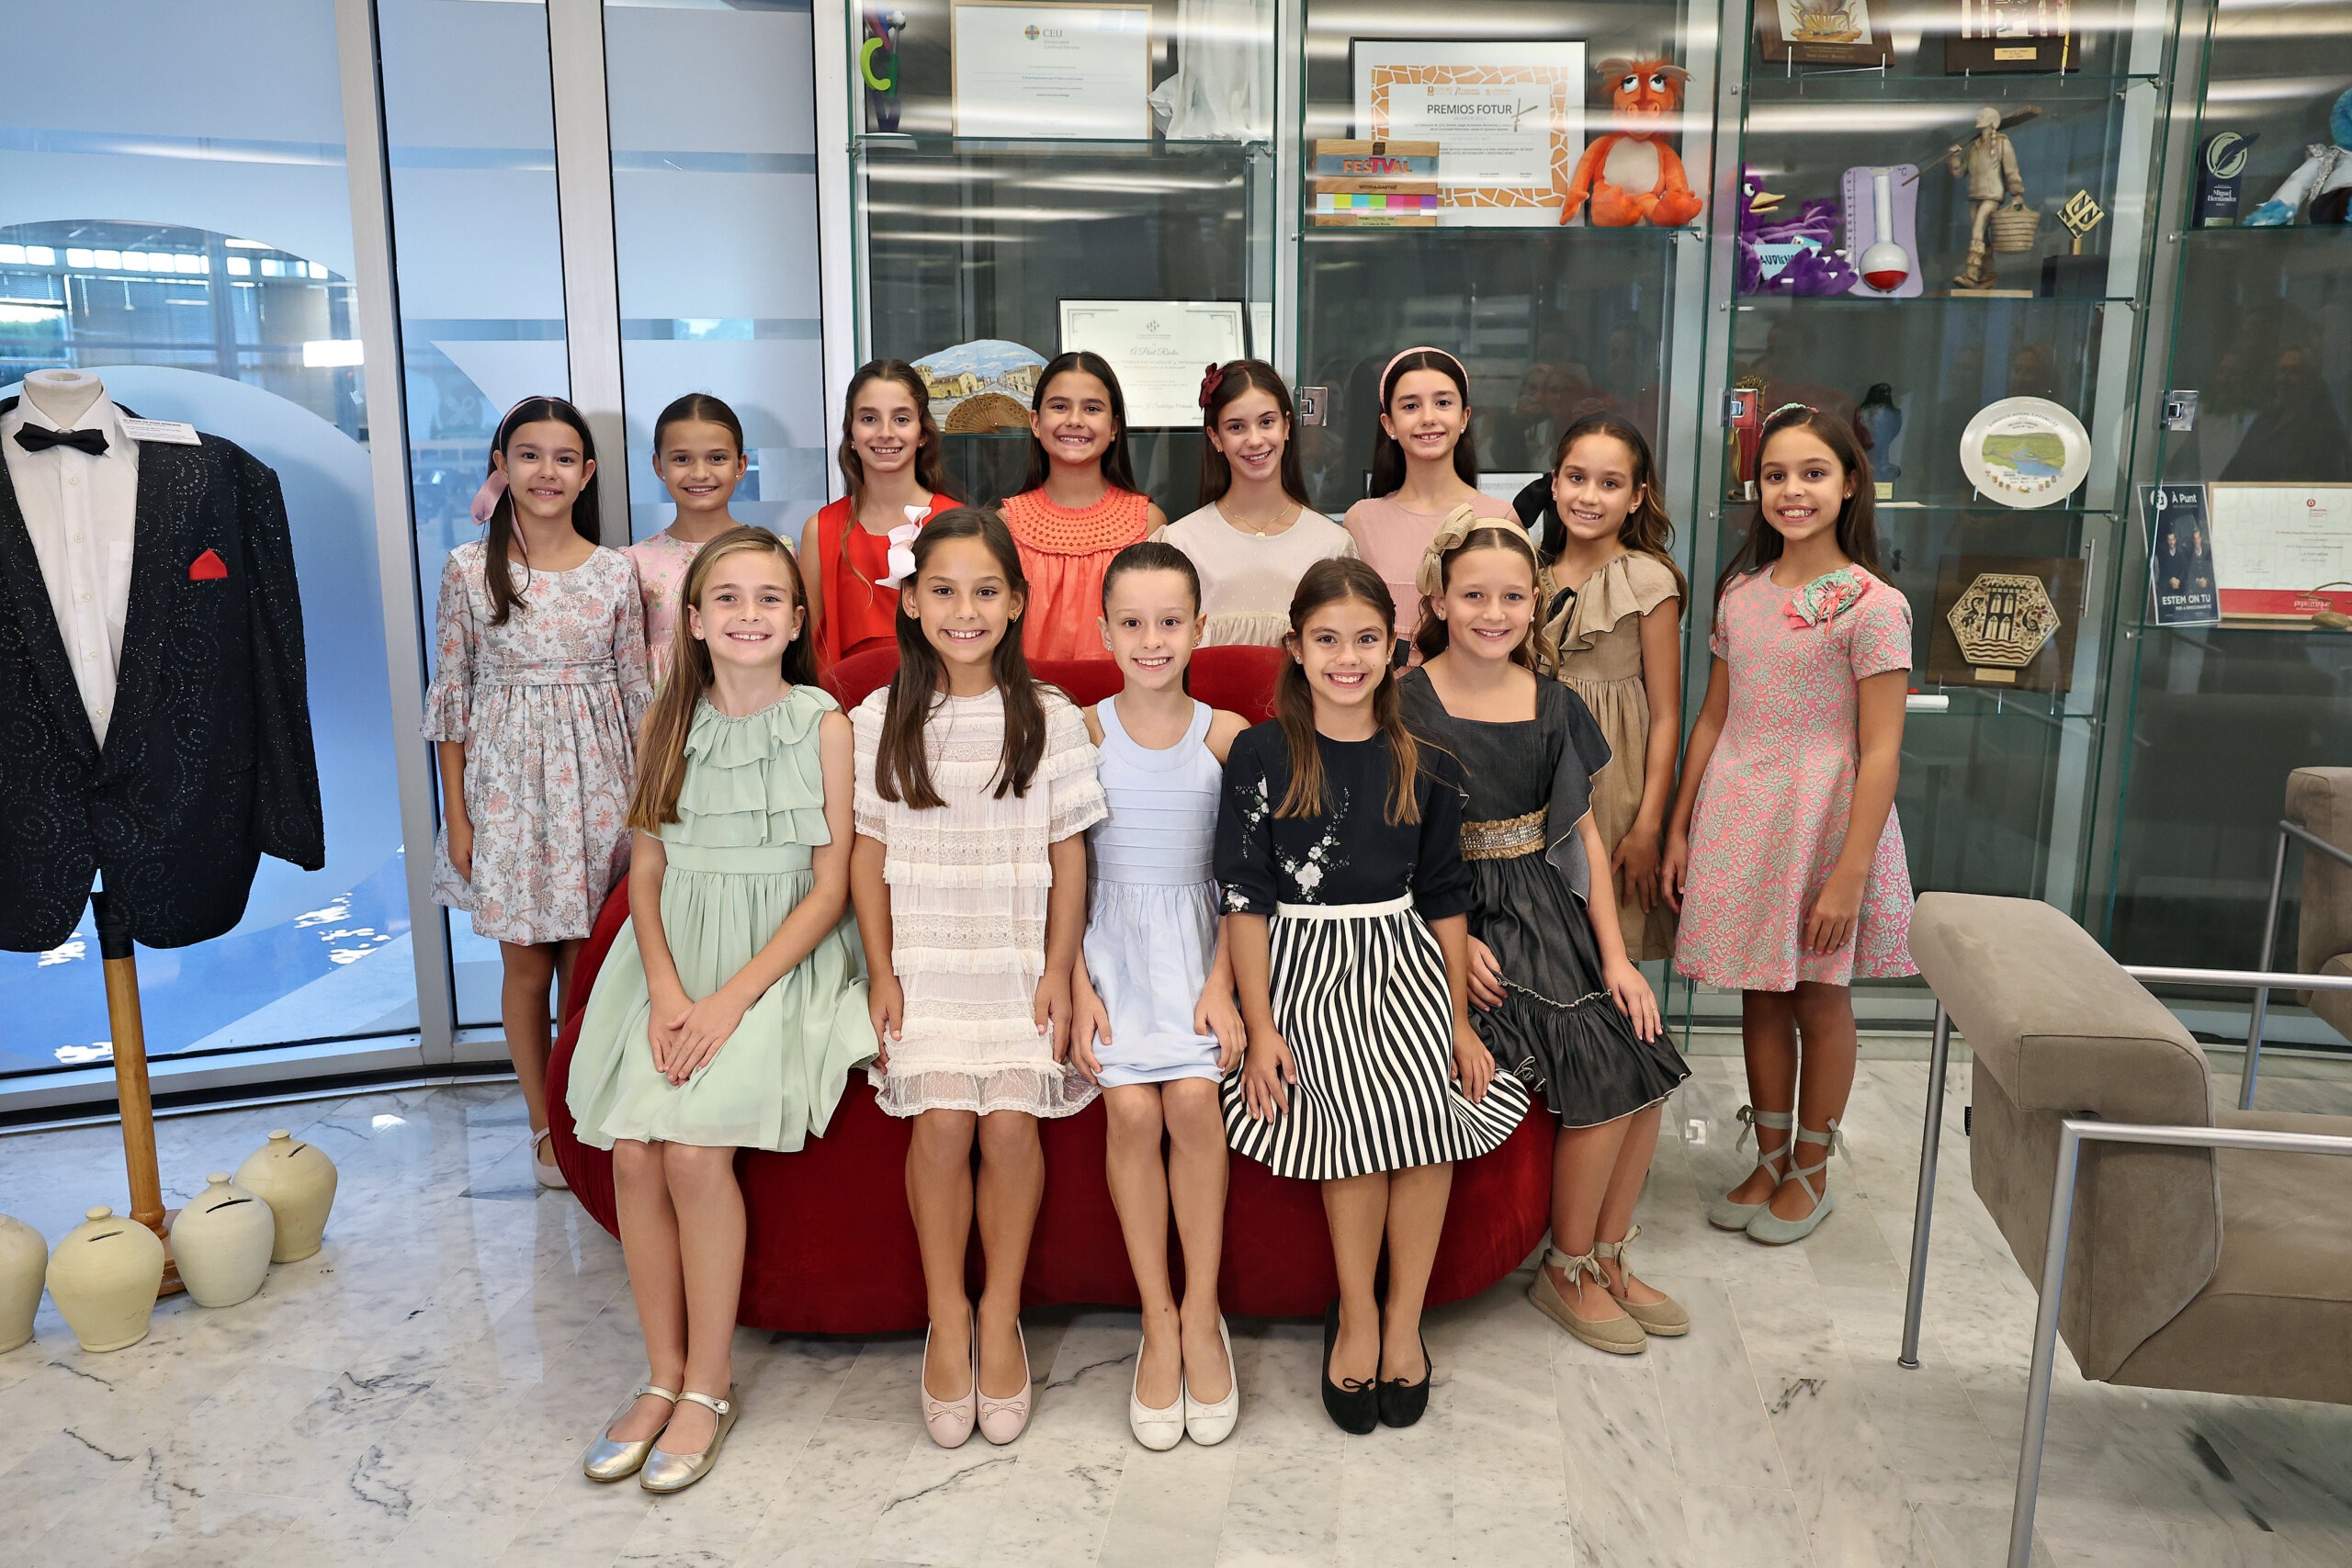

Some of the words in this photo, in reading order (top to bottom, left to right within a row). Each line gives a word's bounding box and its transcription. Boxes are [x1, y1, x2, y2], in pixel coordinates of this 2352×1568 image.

[1043, 29, 1062, 38] CEU
[1427, 105, 1475, 114] PREMIOS
[1476, 105, 1512, 114] FOTUR
[1343, 157, 1412, 175] FESTVAL
[2172, 491, 2178, 503] À
[2179, 493, 2197, 503] Punt
[2162, 595, 2187, 605] ESTEM
[2188, 594, 2199, 604] ON
[2200, 593, 2211, 603] TU
